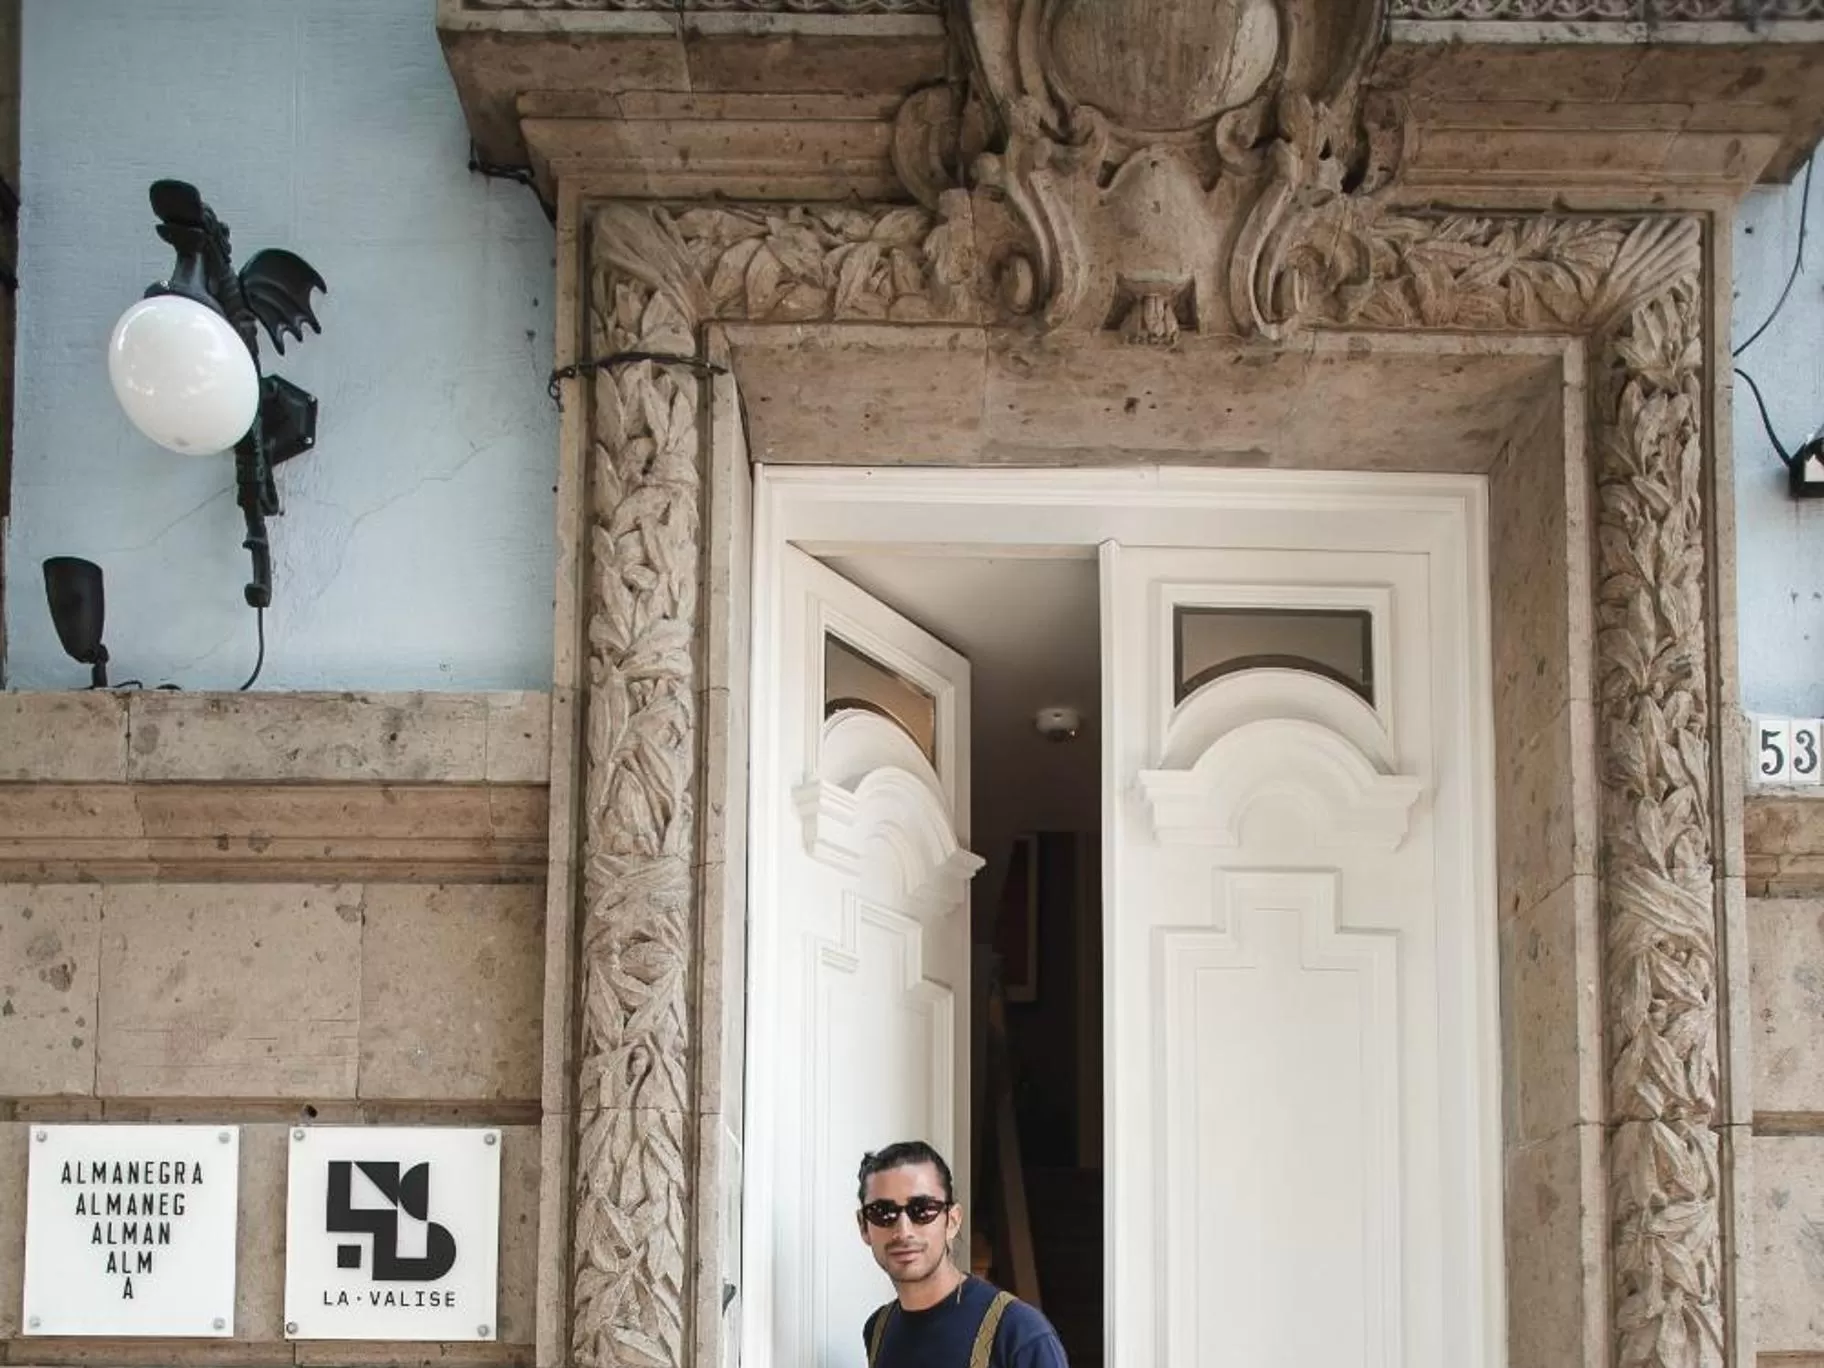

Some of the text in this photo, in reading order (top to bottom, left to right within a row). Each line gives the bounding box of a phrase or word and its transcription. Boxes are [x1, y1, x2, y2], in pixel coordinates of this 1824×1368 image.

[1761, 728, 1818, 776] 53
[60, 1161, 204, 1185] ALMANEGRA
[75, 1192, 186, 1216] ALMANEG
[91, 1221, 171, 1245] ALMAN
[106, 1251, 153, 1274] ALM
[122, 1276, 134, 1300] A
